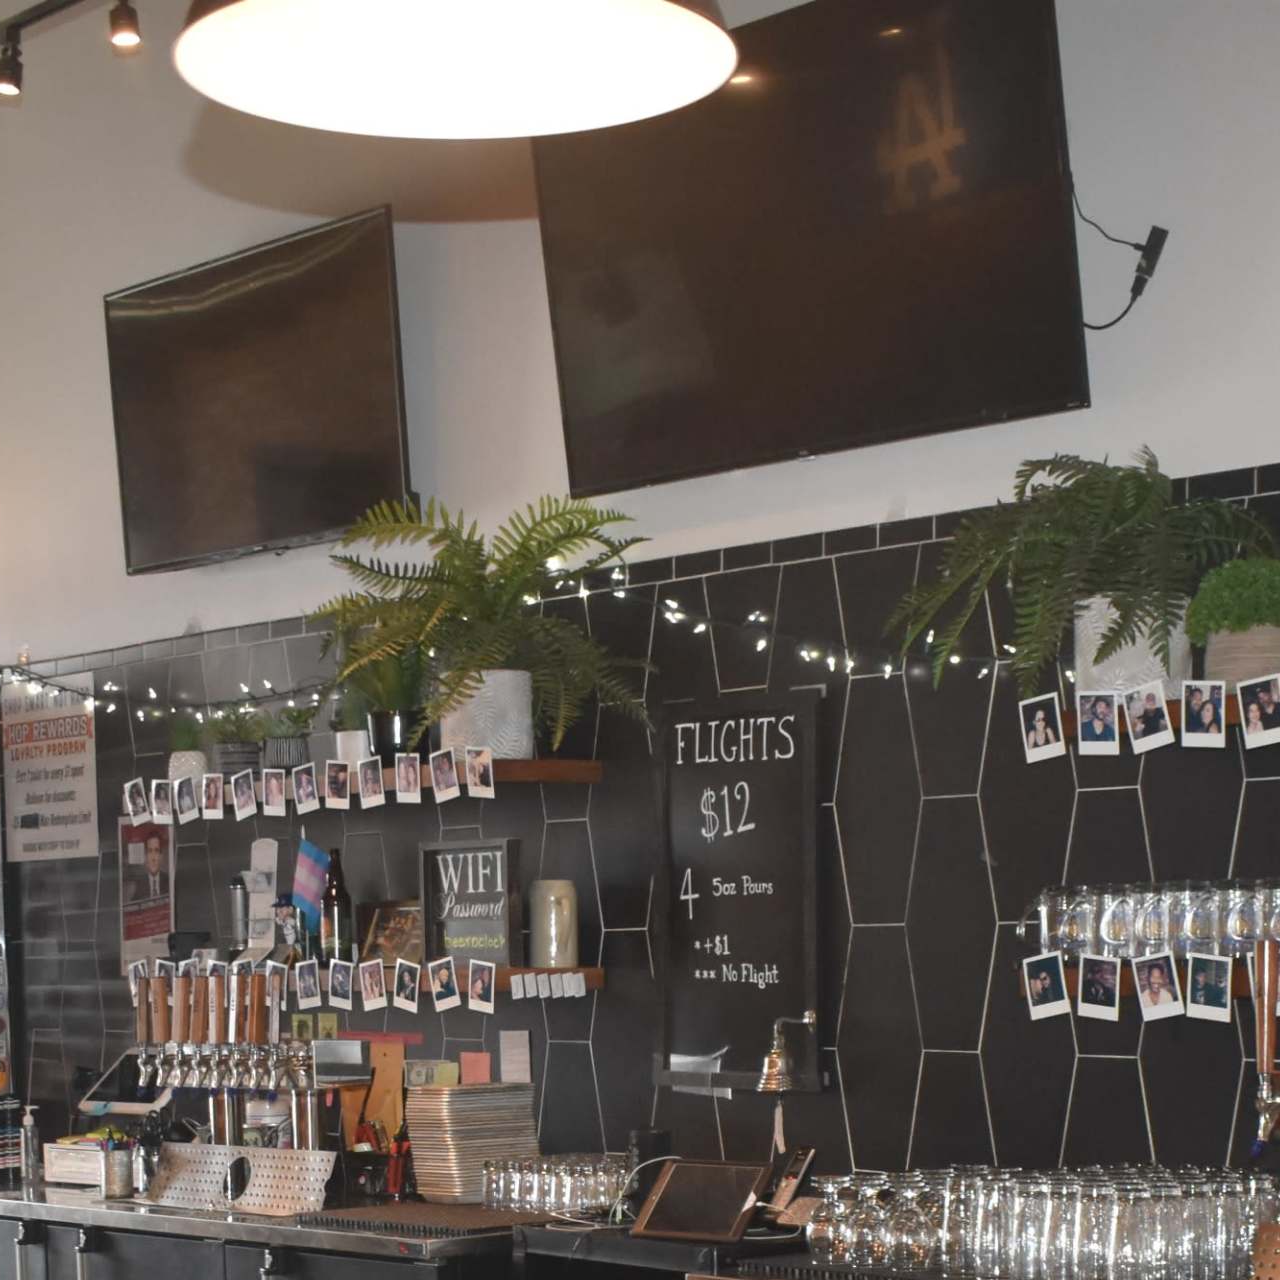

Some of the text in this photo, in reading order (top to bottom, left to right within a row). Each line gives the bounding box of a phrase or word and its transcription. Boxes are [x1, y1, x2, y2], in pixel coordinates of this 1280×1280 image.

[33, 716, 88, 741] REWARDS
[674, 714, 796, 765] FLIGHTS
[700, 780, 757, 842] $12
[436, 851, 505, 894] WIFI
[679, 867, 774, 920] 4 5oz Pours
[438, 892, 505, 920] Password
[721, 964, 738, 983] No
[741, 963, 780, 989] Flight
